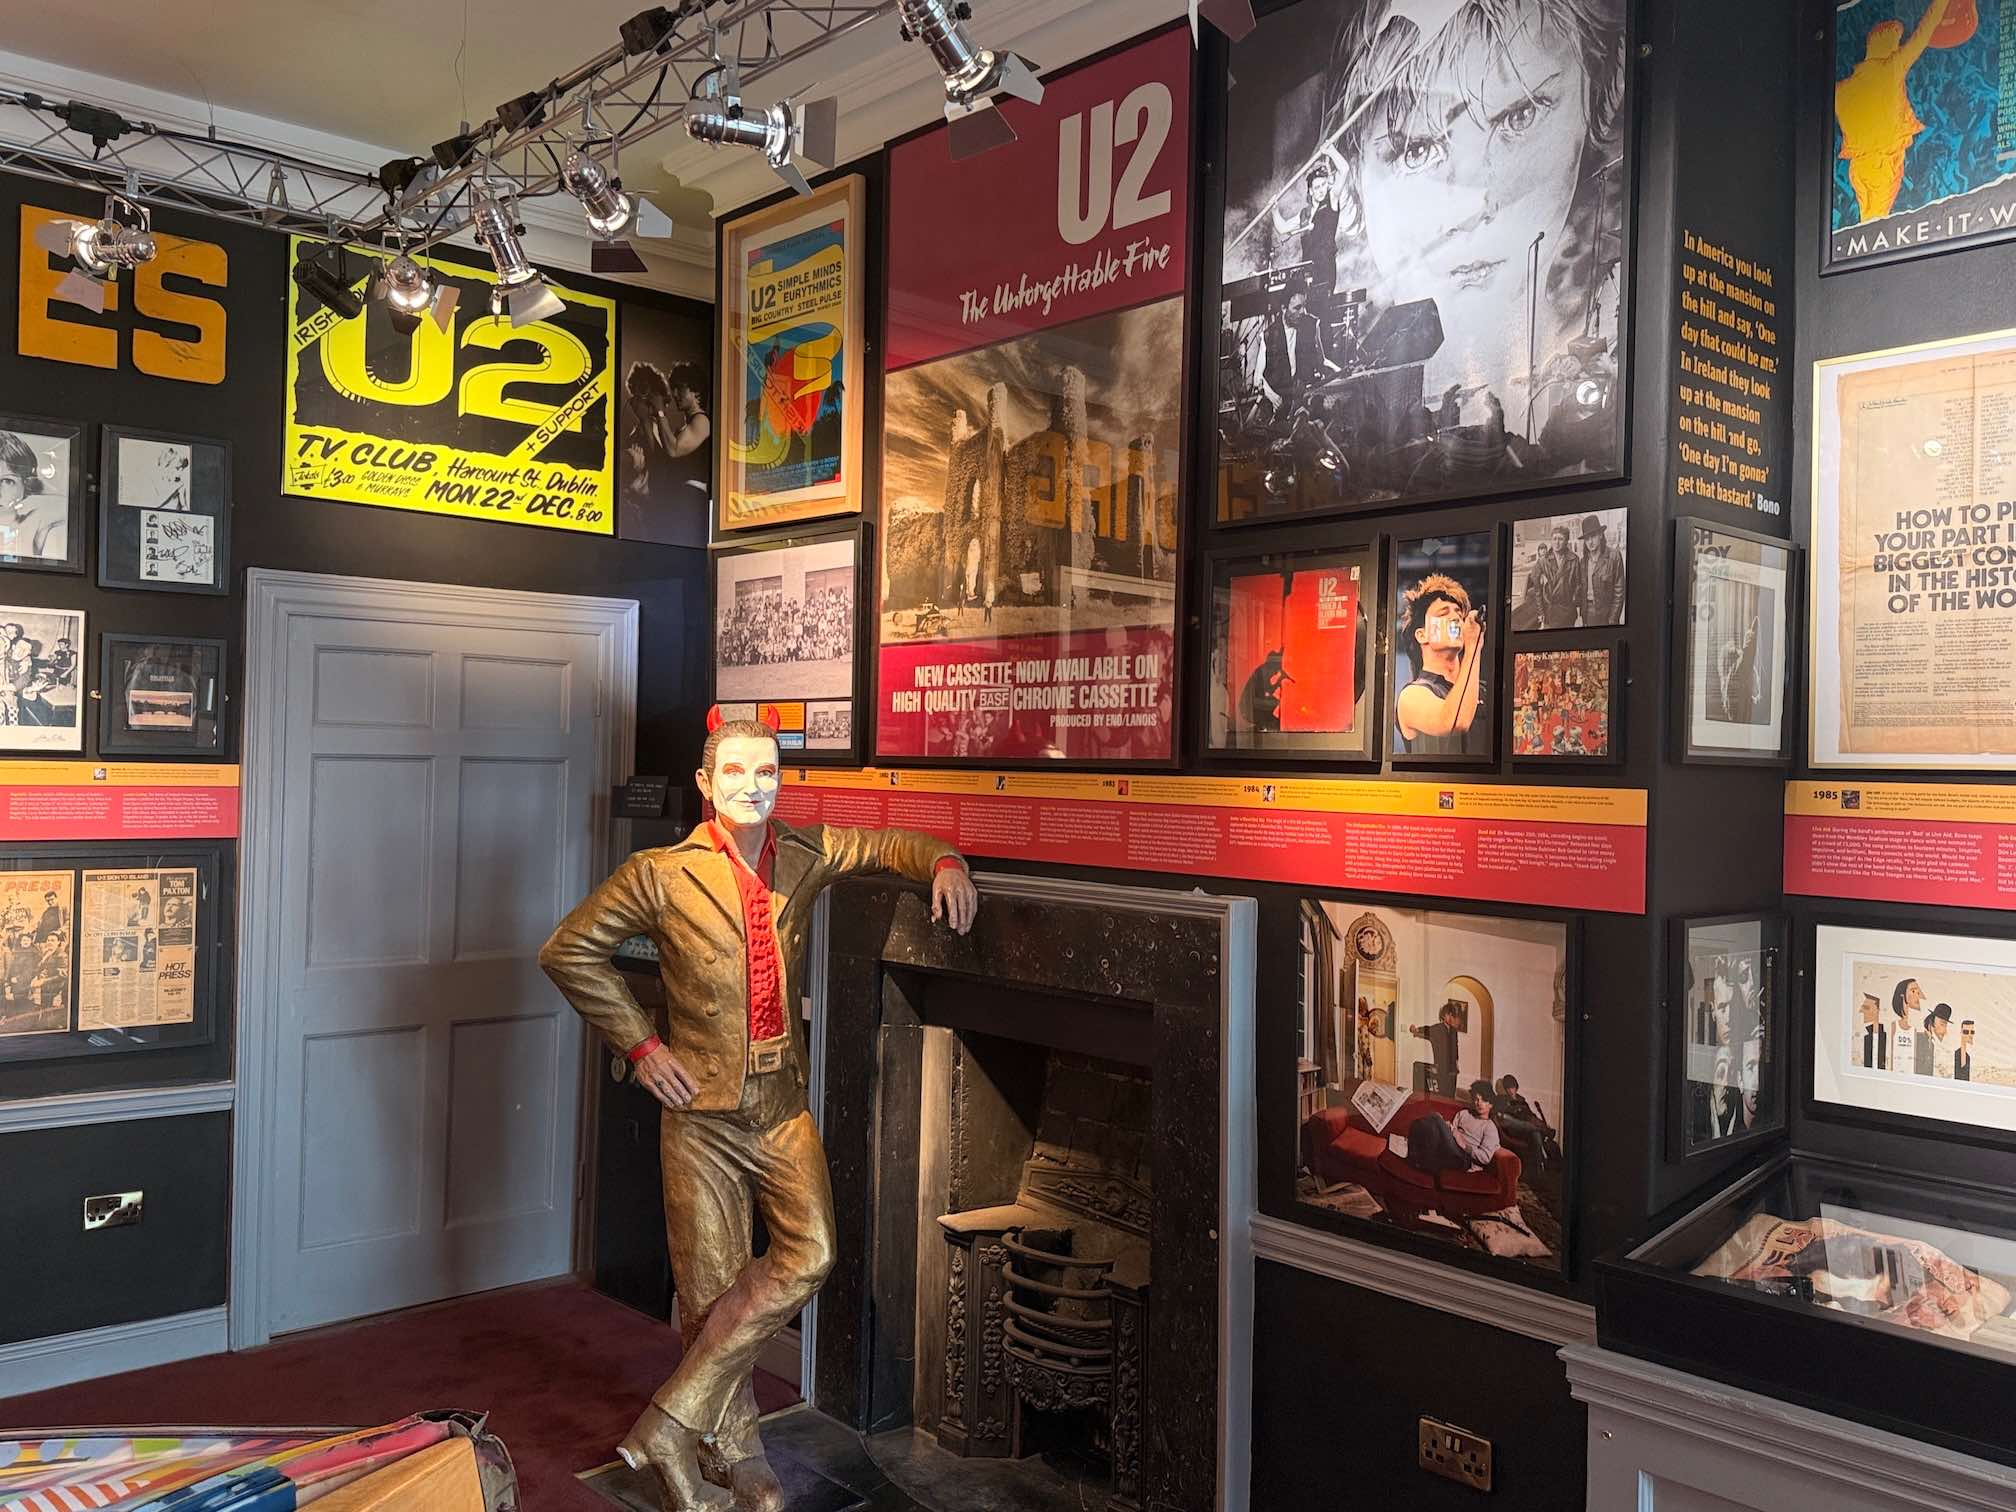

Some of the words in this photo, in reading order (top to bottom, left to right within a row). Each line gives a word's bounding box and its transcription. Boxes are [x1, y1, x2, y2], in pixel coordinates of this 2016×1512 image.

[1058, 82, 1172, 245] U2
[1848, 220, 1929, 256] MAKE
[1948, 212, 1971, 236] IT
[1684, 230, 1695, 251] In
[1697, 236, 1734, 269] America
[1736, 258, 1751, 278] you
[1754, 262, 1772, 287] look
[778, 272, 809, 291] SIMPLE
[813, 261, 842, 280] MINDS
[960, 290, 988, 324] The
[994, 247, 1120, 316] Unforgettable
[1122, 236, 1171, 277] Fire
[1684, 264, 1695, 284] up
[1698, 270, 1707, 287] at
[1709, 272, 1724, 294] the
[1726, 283, 1762, 311] mansion
[1764, 302, 1774, 316] on
[18, 204, 228, 385] ES
[752, 284, 776, 312] U2
[784, 276, 842, 302] EURYTHMICS
[752, 316, 762, 324] BIG
[764, 306, 794, 320] COUNTRY
[798, 298, 818, 311] STEEL
[820, 290, 841, 304] PULSE
[294, 309, 341, 345] IRISH
[1682, 291, 1698, 312] the
[1700, 297, 1716, 320] hill
[1718, 309, 1735, 328] and
[1736, 318, 1753, 338] say,
[1681, 321, 1698, 347] day
[1700, 329, 1720, 352] that
[1721, 341, 1746, 362] could
[1748, 345, 1758, 366] be
[320, 300, 592, 431] U2
[1681, 351, 1691, 370] In
[1694, 359, 1727, 384] Ireland
[1729, 370, 1749, 395] they
[1751, 376, 1771, 400] look
[536, 382, 599, 444] SUPPORT
[1680, 384, 1692, 406] up
[1694, 390, 1704, 406] at
[1705, 391, 1720, 412] the
[1722, 400, 1760, 425] mansion
[1680, 416, 1692, 432] on
[1694, 417, 1709, 438] the
[1710, 421, 1726, 444] hill
[1728, 431, 1745, 448] and
[1746, 438, 1762, 456] go,
[361, 470, 394, 482] GOLDEN
[448, 457, 520, 484] Harcourt
[1702, 449, 1720, 474] day
[365, 483, 411, 498] MURRAYS
[1678, 476, 1694, 496] get
[1696, 477, 1716, 499] that
[1756, 494, 1780, 516] Bono
[1896, 507, 1952, 530] HOW
[1959, 504, 1991, 524] TO
[1874, 530, 1935, 552] YOUR
[1942, 524, 2000, 548] PART
[1874, 549, 1966, 572] BIGGEST
[1319, 577, 1337, 596] U2
[1888, 574, 1910, 592] IN
[1918, 570, 1958, 591] THE
[1966, 566, 2016, 588] HIST
[1888, 594, 1920, 614] OF
[1928, 591, 1970, 612] THE
[914, 664, 944, 688] NEW
[946, 662, 1012, 686] CASSETTE
[1016, 659, 1050, 684] NOW
[1053, 656, 1130, 681] AVAILABLE
[1135, 654, 1158, 678] ON
[1526, 652, 1541, 662] They
[892, 691, 921, 713] HIGH
[924, 688, 976, 712] QUALITY
[980, 692, 1009, 707] BASF
[1014, 686, 1074, 711] CHROME
[1078, 683, 1157, 709] CASSETTE
[1050, 714, 1091, 728] PRODUCED
[1094, 714, 1104, 727] BY
[1106, 713, 1157, 727] ENO/LANOIS
[1814, 790, 1838, 800] 1985
[159, 970, 192, 980] PRESS
[165, 962, 186, 970] HOT
